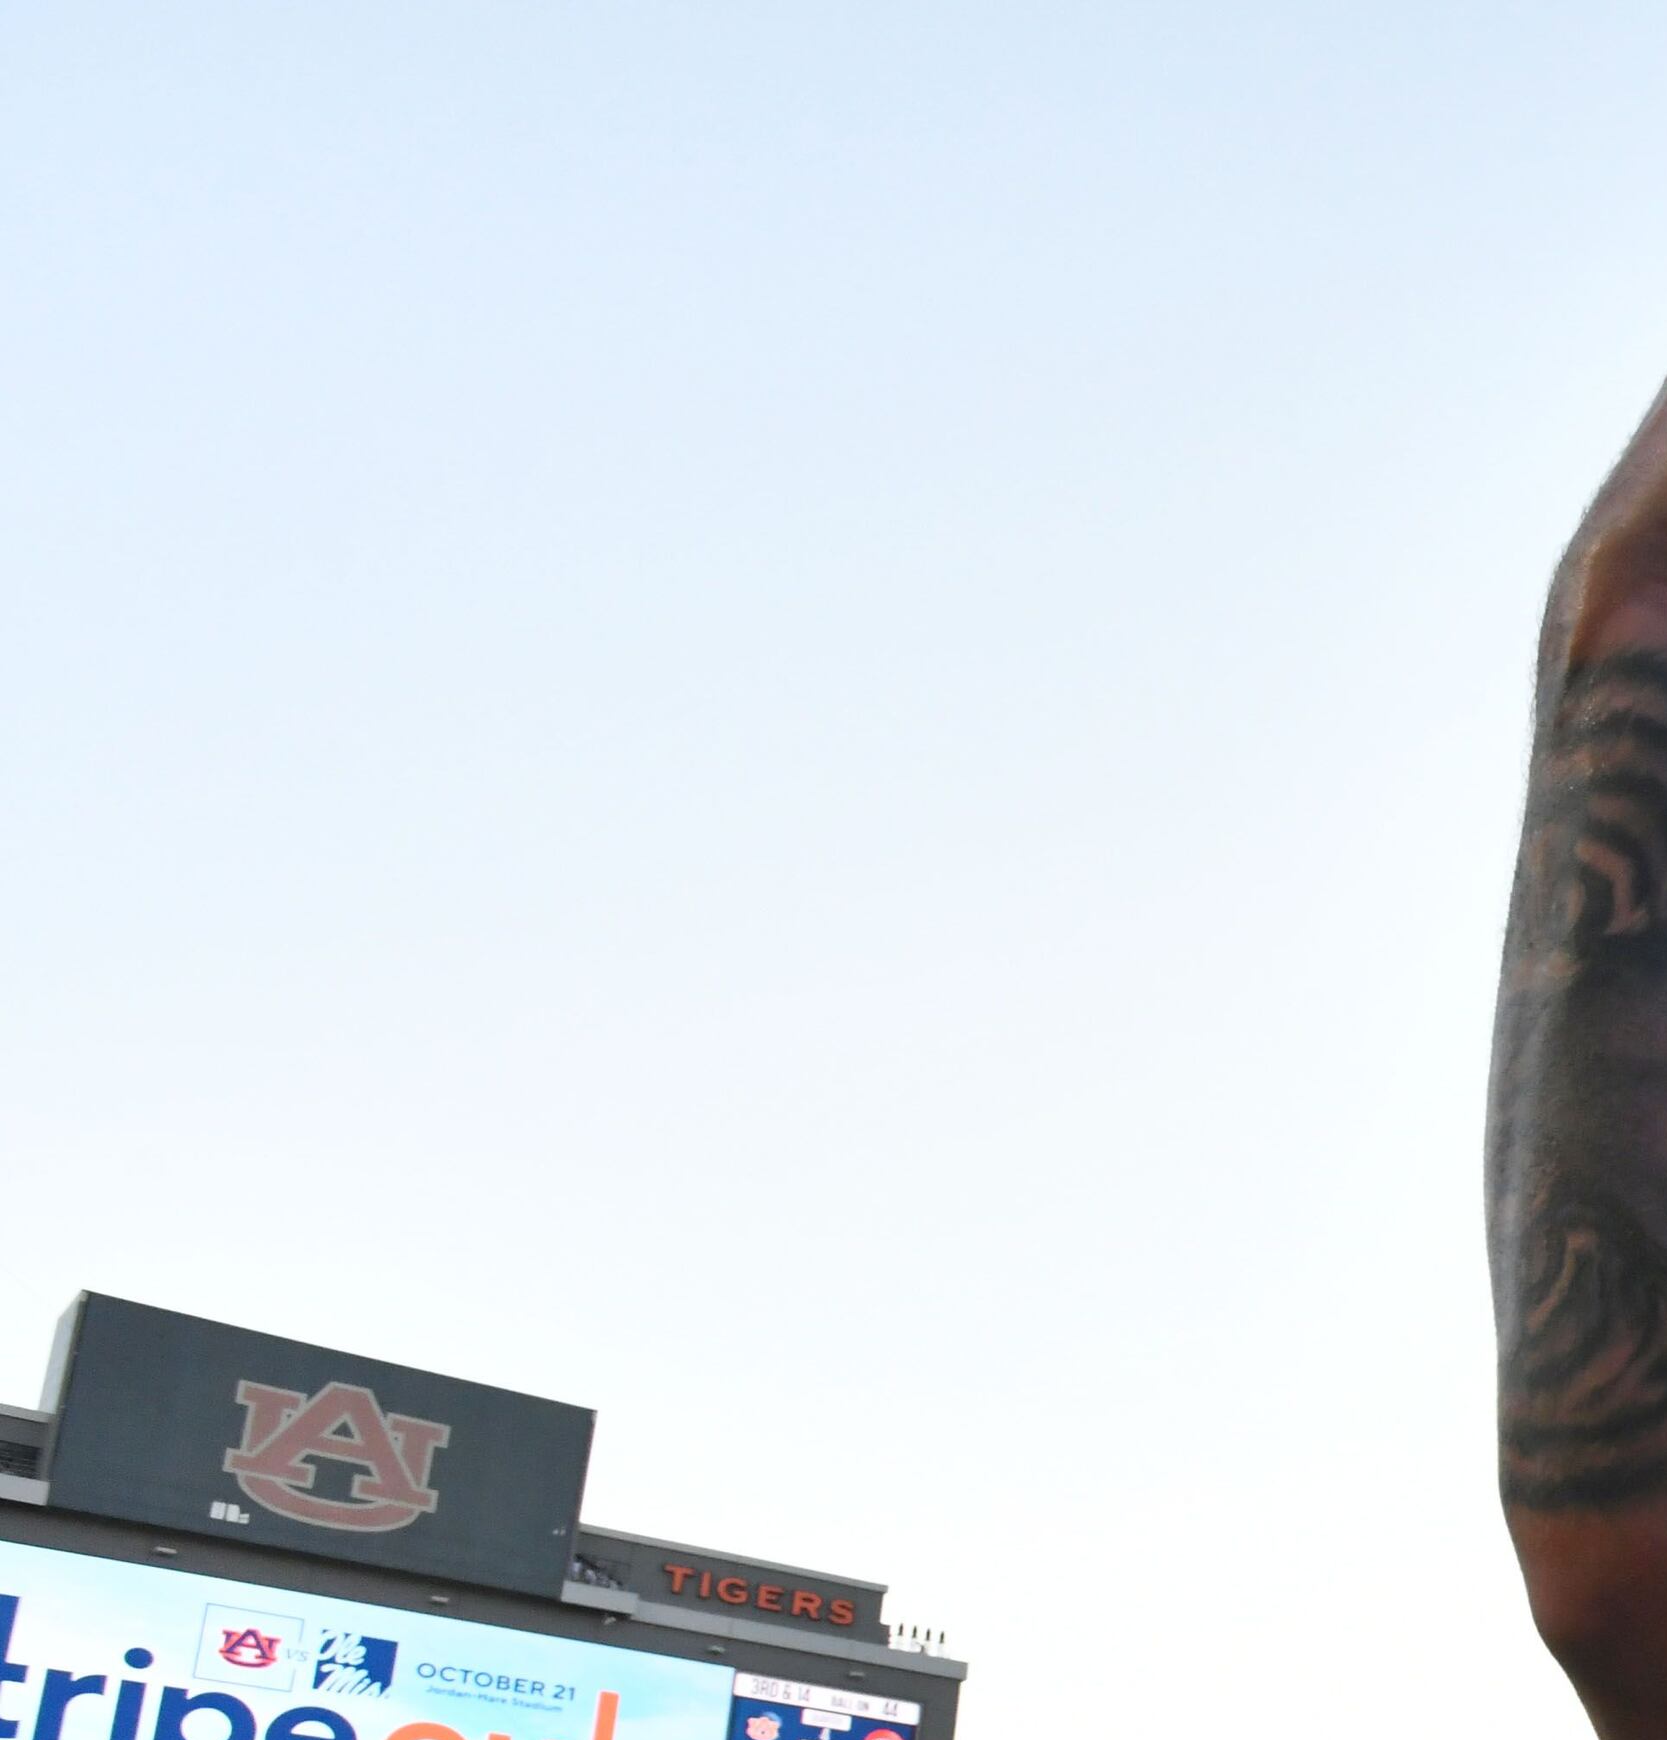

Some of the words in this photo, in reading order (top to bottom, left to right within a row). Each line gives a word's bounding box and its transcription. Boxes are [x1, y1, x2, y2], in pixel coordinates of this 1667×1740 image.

[662, 1562, 856, 1626] TIGERS
[416, 1662, 545, 1696] OCTOBER
[552, 1684, 576, 1701] 21
